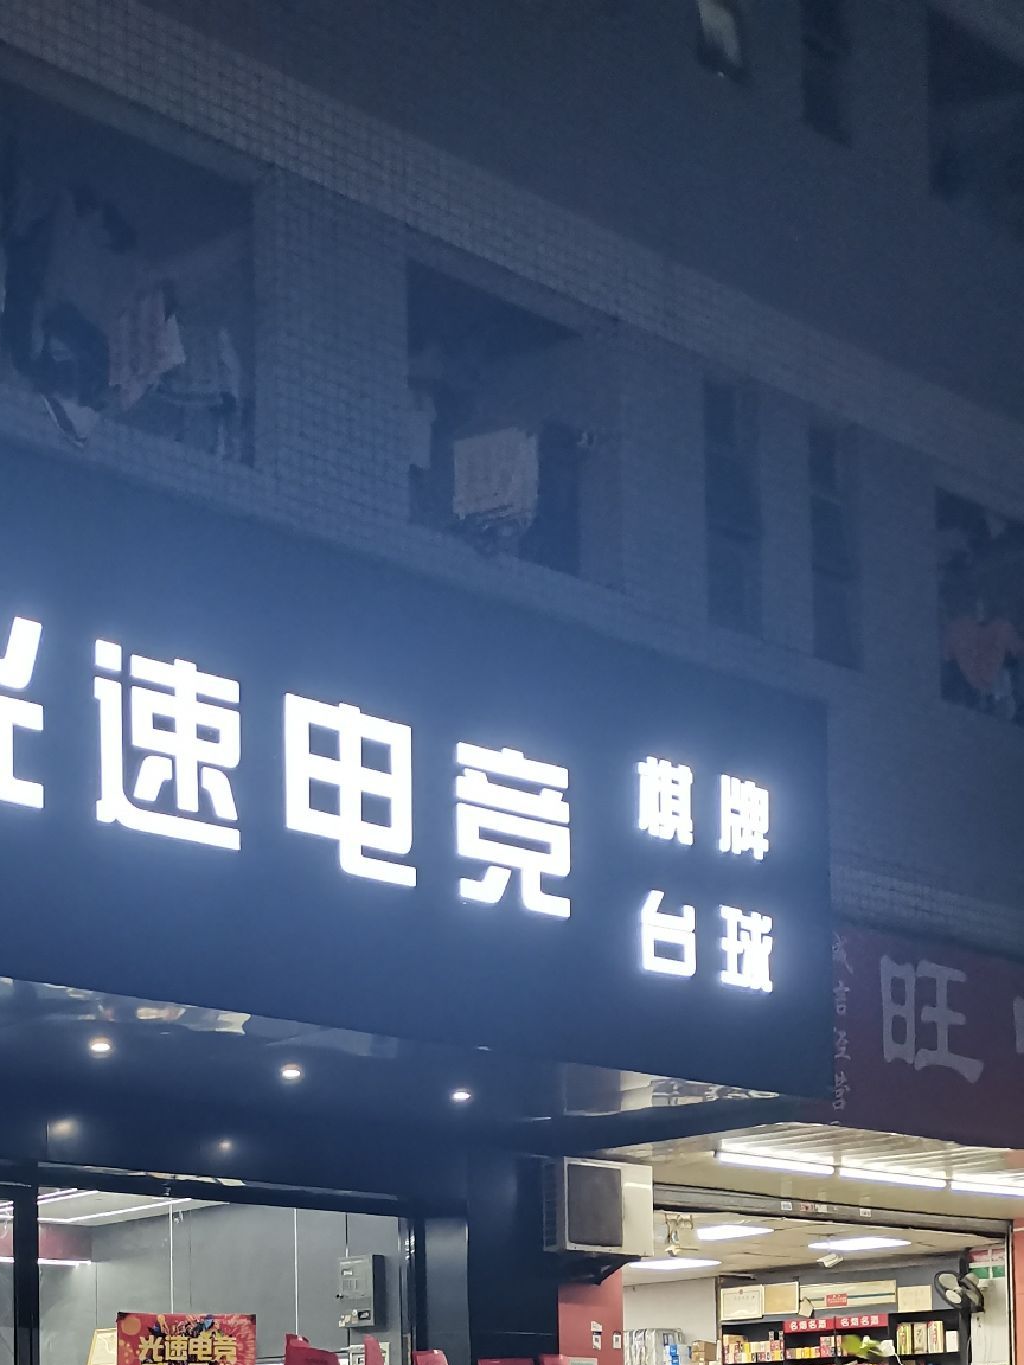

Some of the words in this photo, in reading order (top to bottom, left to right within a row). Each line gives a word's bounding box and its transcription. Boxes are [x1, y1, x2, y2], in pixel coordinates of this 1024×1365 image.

[637, 756, 770, 862] 棋牌
[640, 889, 774, 994] 台球
[139, 1334, 238, 1361] 光速电竞
